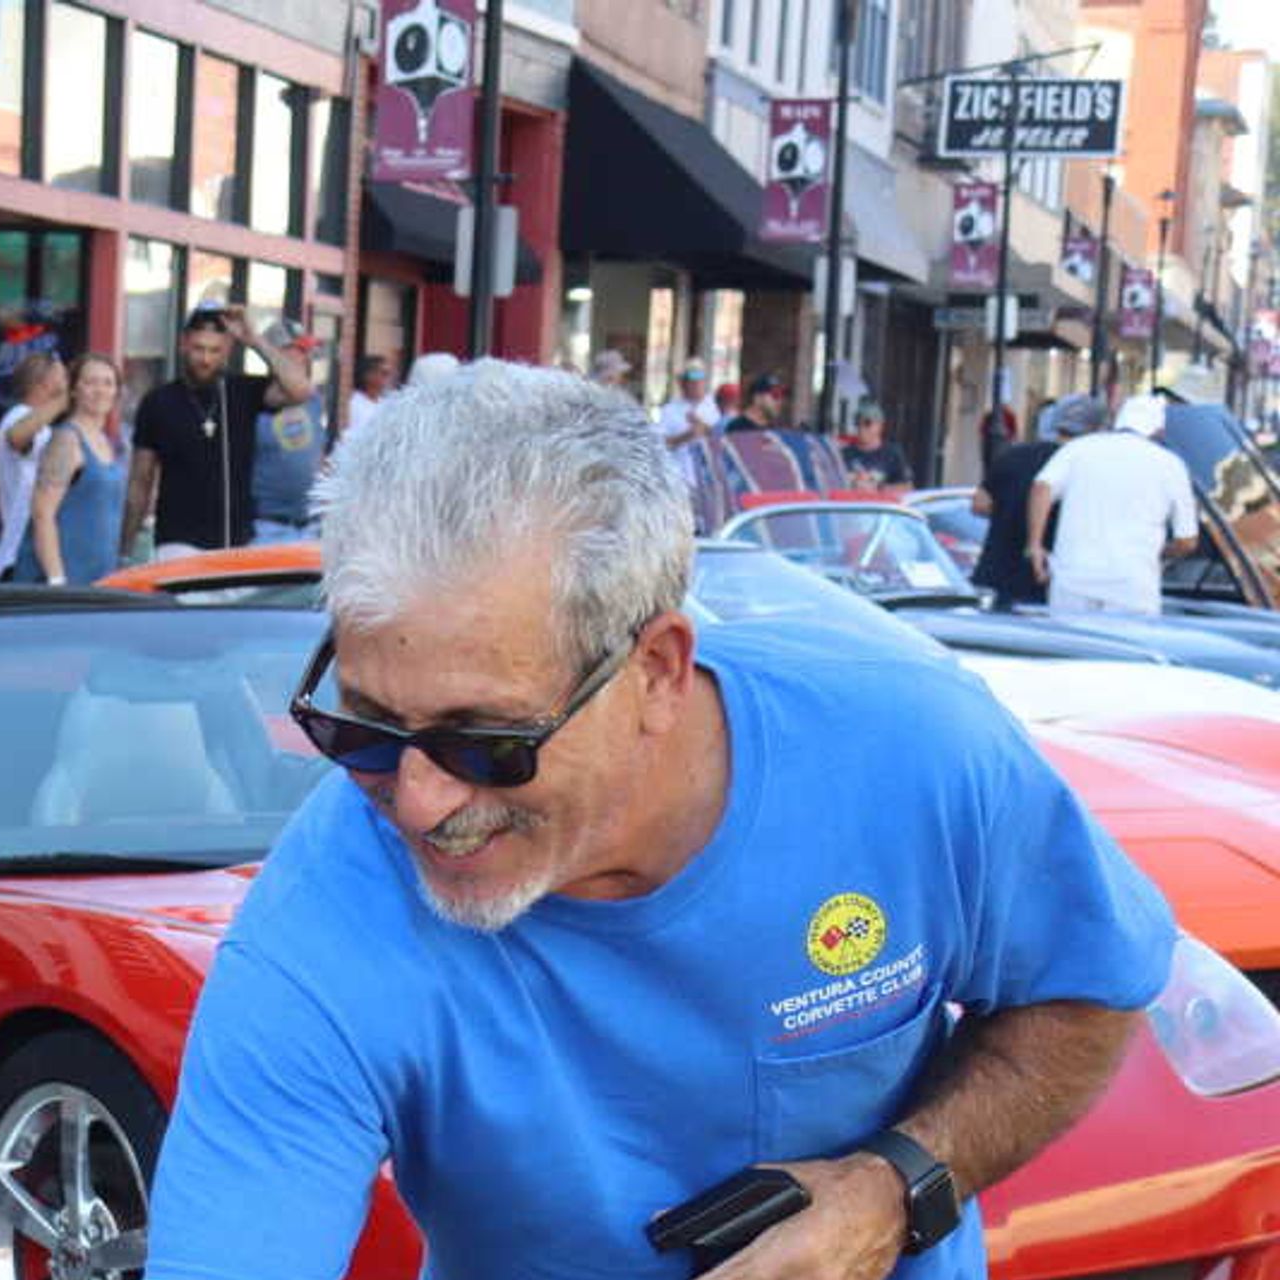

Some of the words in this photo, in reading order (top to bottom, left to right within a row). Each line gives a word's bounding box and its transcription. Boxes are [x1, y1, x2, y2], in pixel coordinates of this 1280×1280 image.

[770, 978, 857, 1016] VENTURA
[859, 942, 924, 986] COUNTY
[783, 987, 878, 1030] CORVETTE
[881, 963, 924, 995] CLUB
